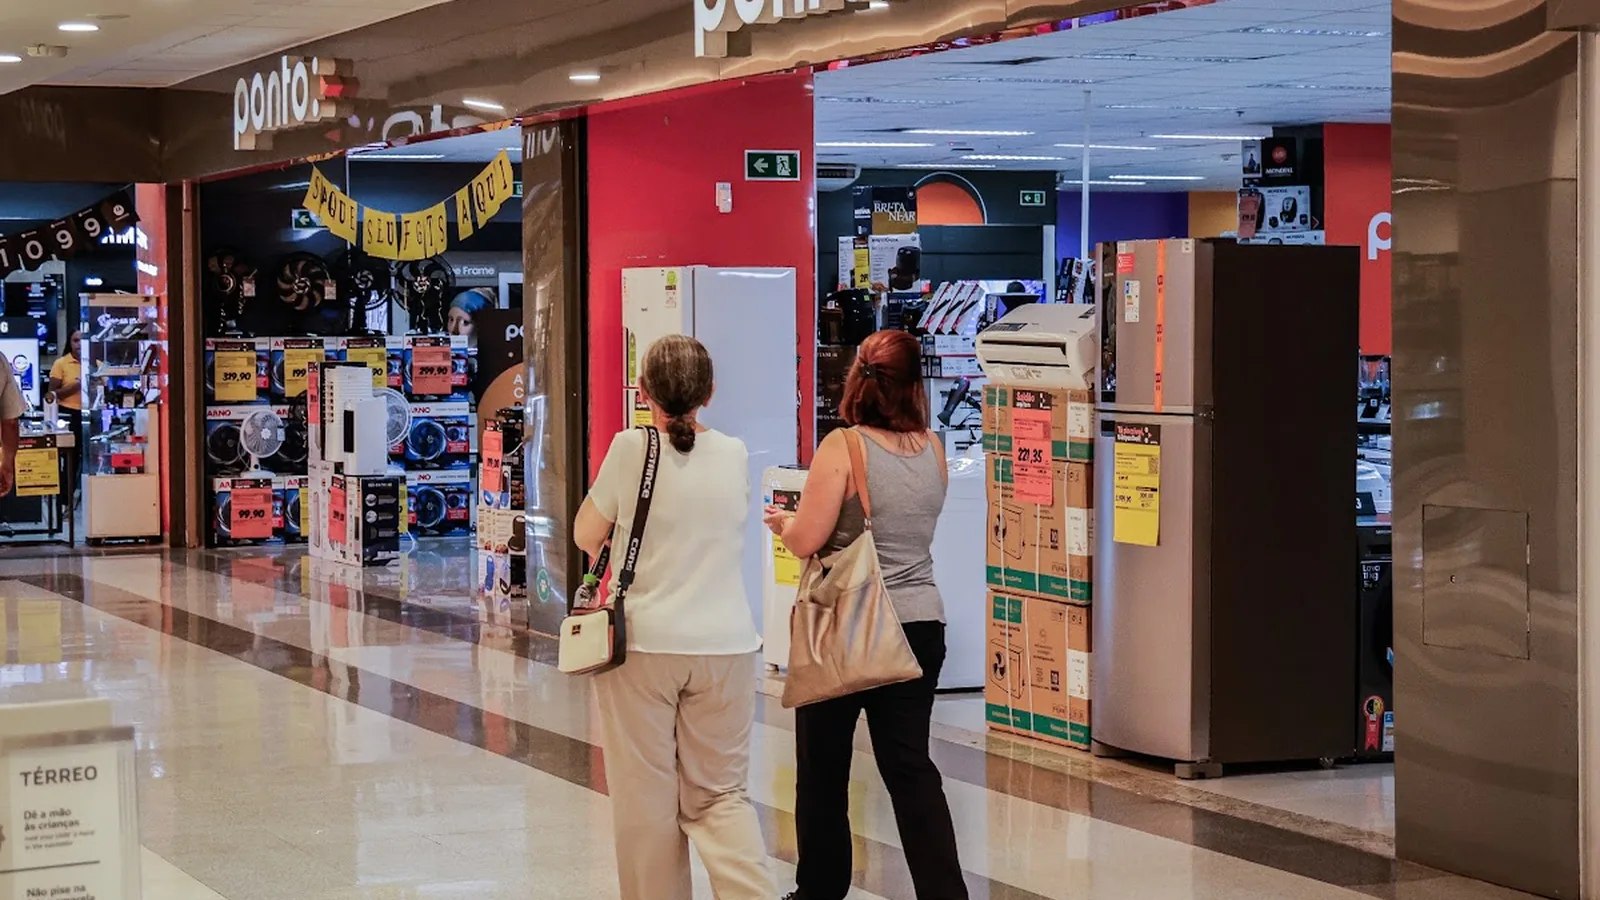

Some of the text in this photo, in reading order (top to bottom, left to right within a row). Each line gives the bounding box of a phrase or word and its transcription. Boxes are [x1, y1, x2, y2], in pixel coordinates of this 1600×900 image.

[403, 214, 445, 250] FGTS
[463, 266, 495, 276] Frame
[222, 371, 252, 382] 319,90
[419, 366, 448, 375] 299,90
[207, 409, 232, 417] ARNO
[238, 509, 265, 519] 99,90
[20, 765, 98, 787] TÉRREO
[23, 810, 38, 821] Dê
[49, 808, 72, 818] mão
[24, 818, 80, 832] às crianças
[26, 887, 48, 898] Não
[50, 885, 71, 898] pise
[73, 884, 86, 893] na
